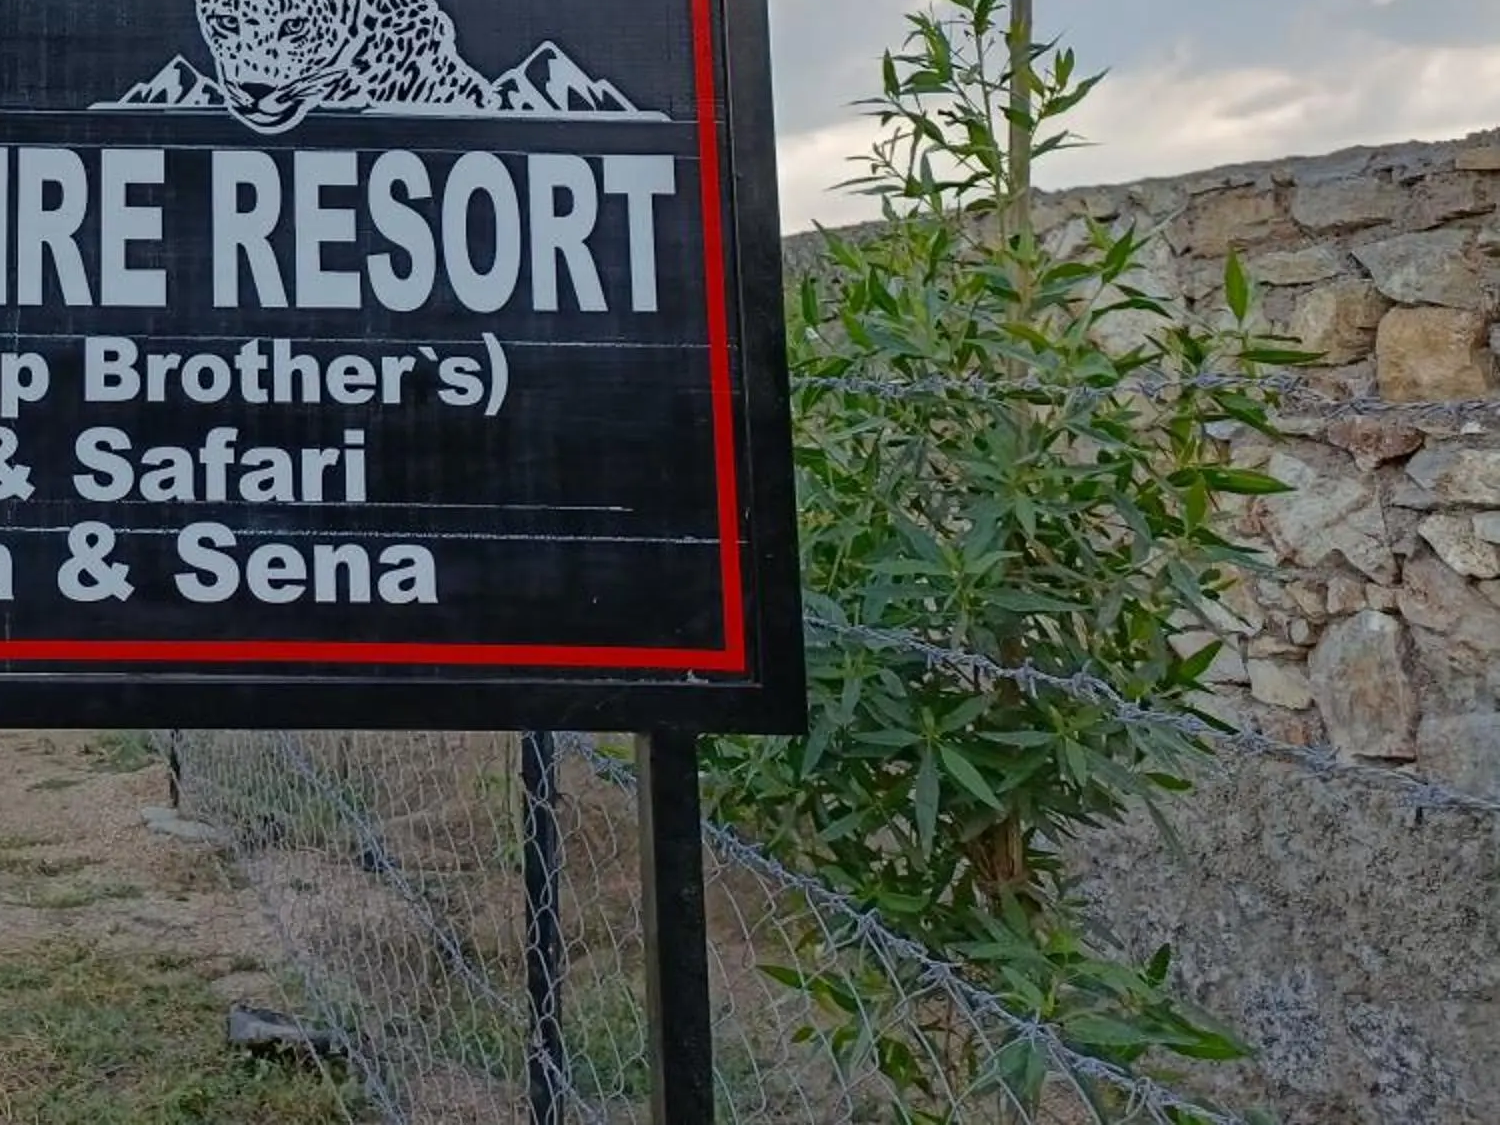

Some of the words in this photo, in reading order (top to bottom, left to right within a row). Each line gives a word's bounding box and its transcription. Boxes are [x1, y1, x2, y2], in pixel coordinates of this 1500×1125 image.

[212, 150, 676, 313] RESORT
[73, 427, 368, 503] Safari
[57, 521, 135, 603] &
[174, 522, 440, 604] Sena
